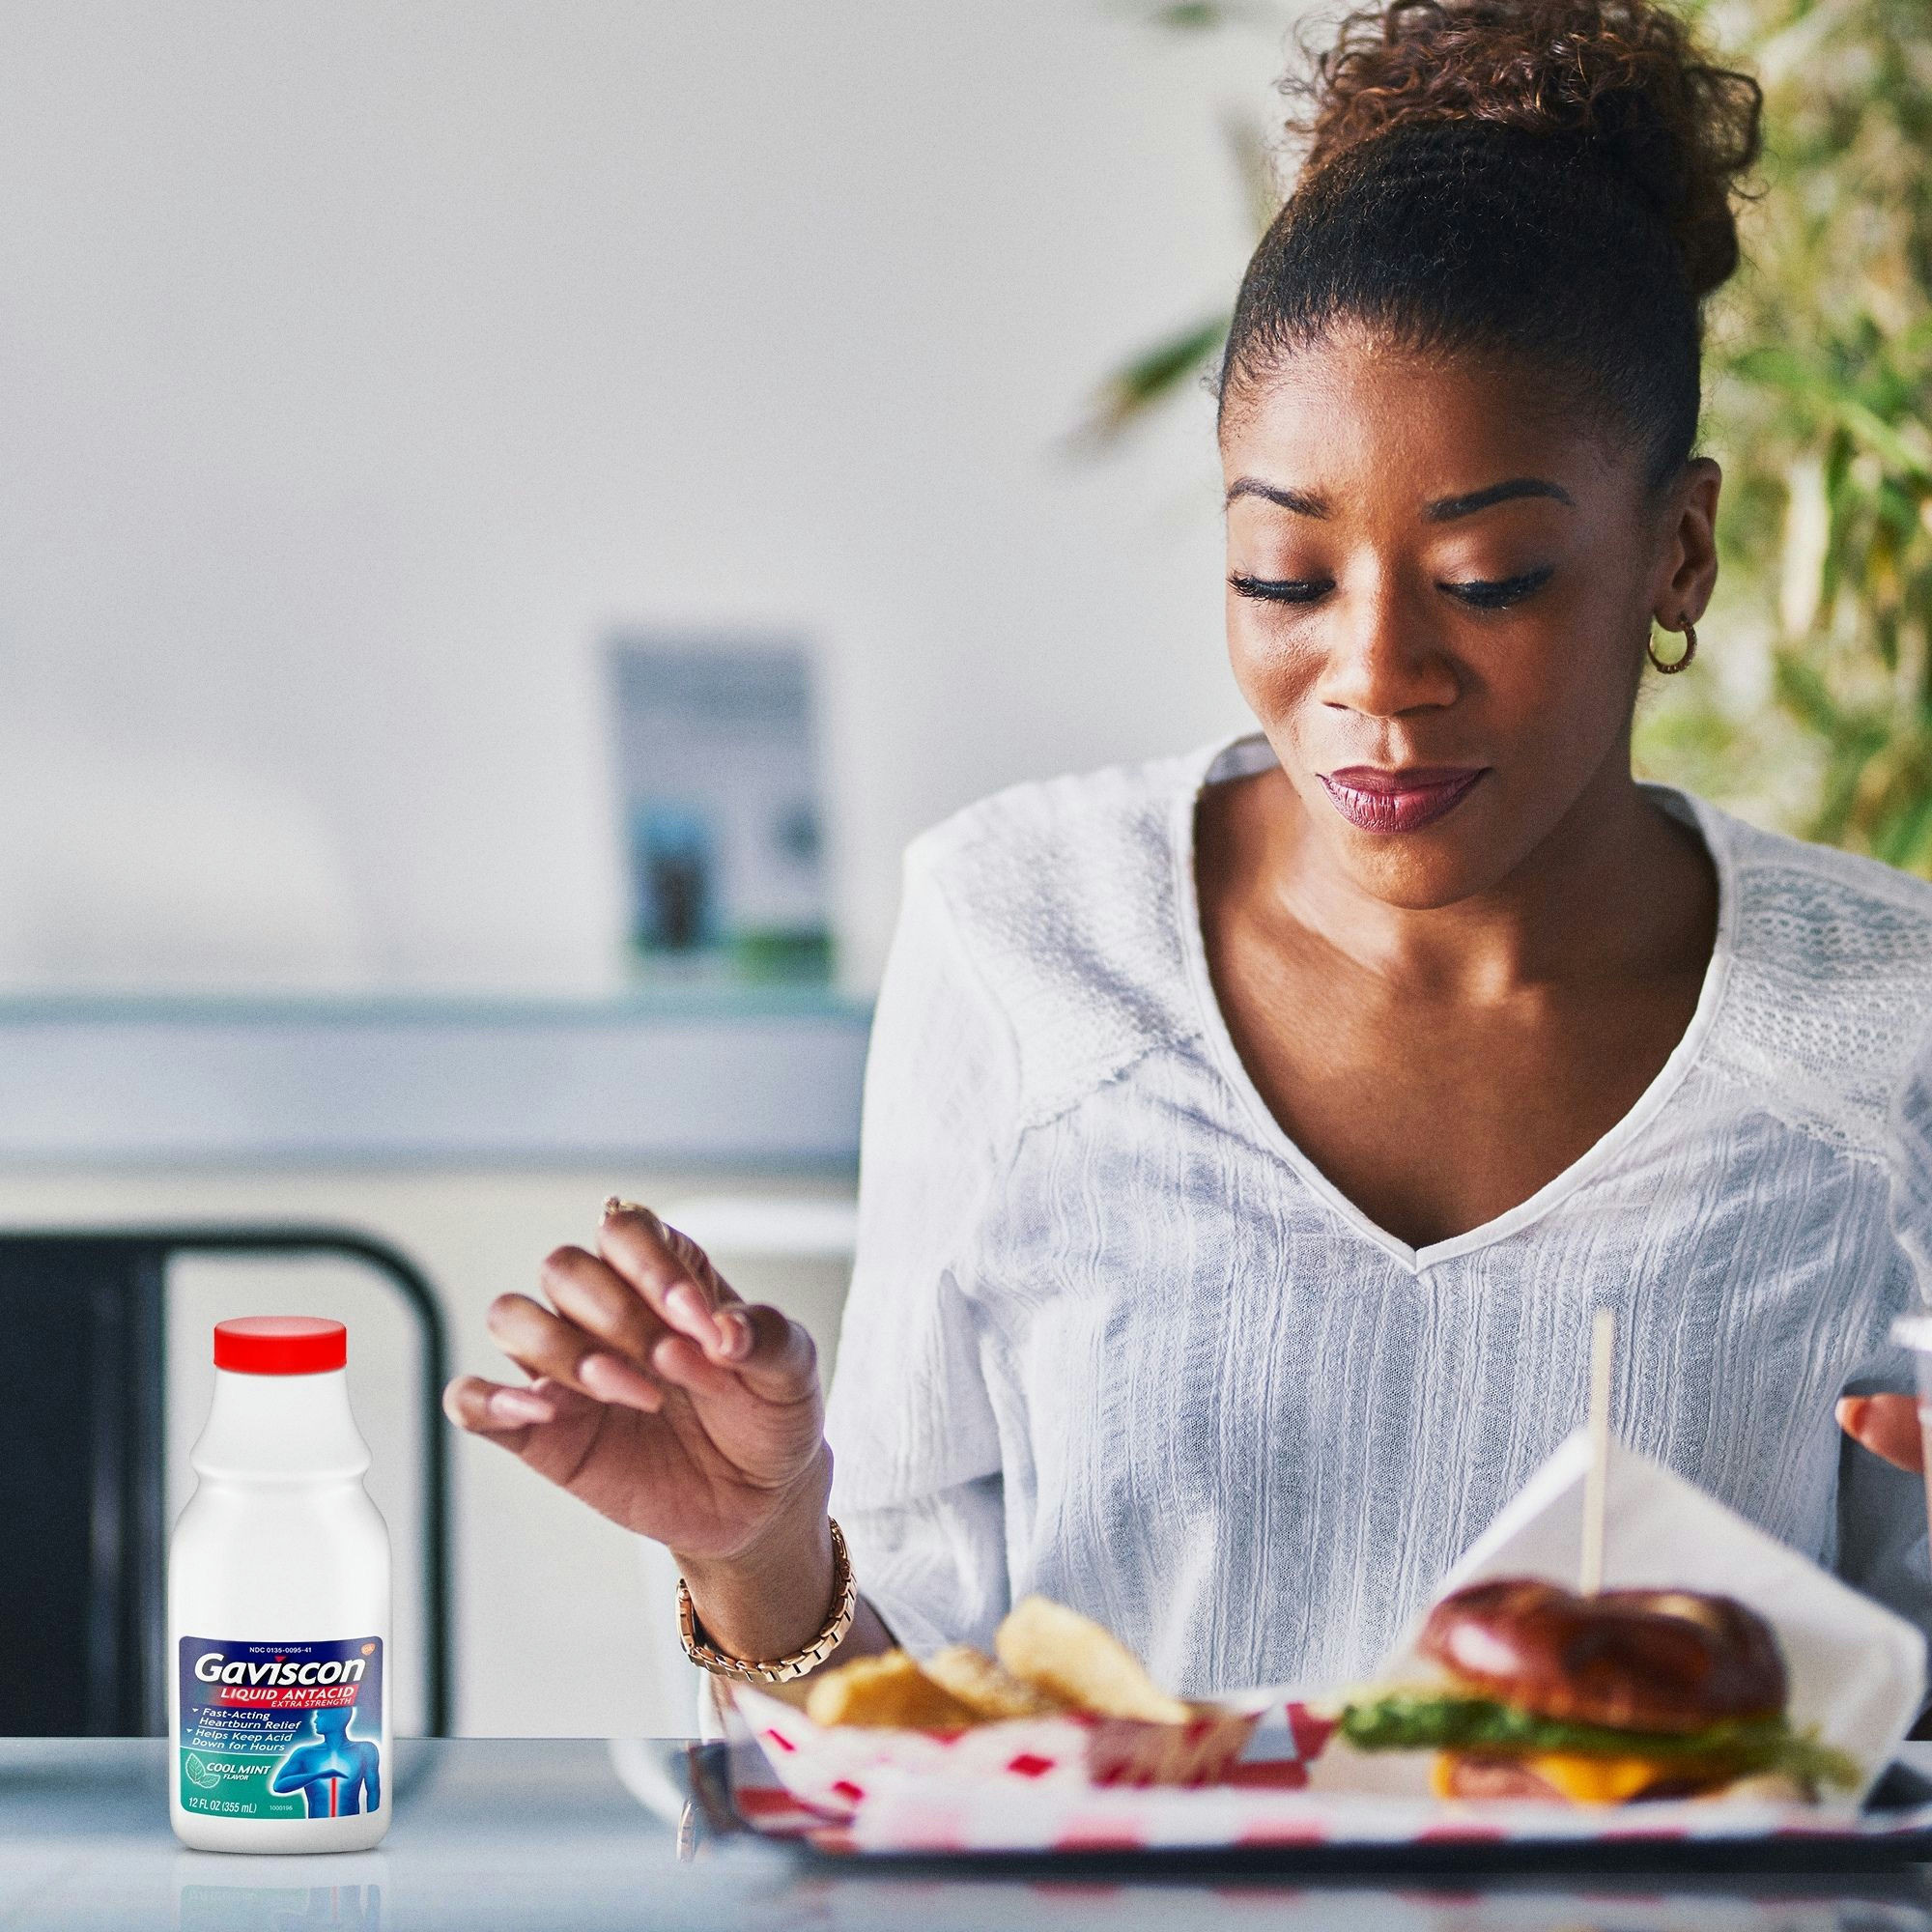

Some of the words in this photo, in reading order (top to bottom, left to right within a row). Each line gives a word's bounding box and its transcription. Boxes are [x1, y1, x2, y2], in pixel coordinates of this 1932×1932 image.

[195, 1653, 366, 1685] Gaviscon
[221, 1688, 277, 1701] LIQUID
[281, 1686, 354, 1699] ANTACID
[203, 1708, 270, 1720] Fast-Acting
[200, 1718, 261, 1728] Heartburn
[265, 1721, 301, 1730] Relief
[195, 1728, 228, 1740] Helps
[232, 1732, 263, 1742] Keep
[267, 1733, 293, 1742] Acid
[192, 1739, 224, 1748] Down
[229, 1741, 246, 1750] for
[207, 1763, 240, 1773] COOL
[240, 1765, 270, 1775] MINT
[189, 1798, 198, 1807] 12
[200, 1799, 209, 1809] FL
[211, 1802, 221, 1811] OZ
[221, 1802, 240, 1812] (355
[242, 1804, 257, 1813] mL)
